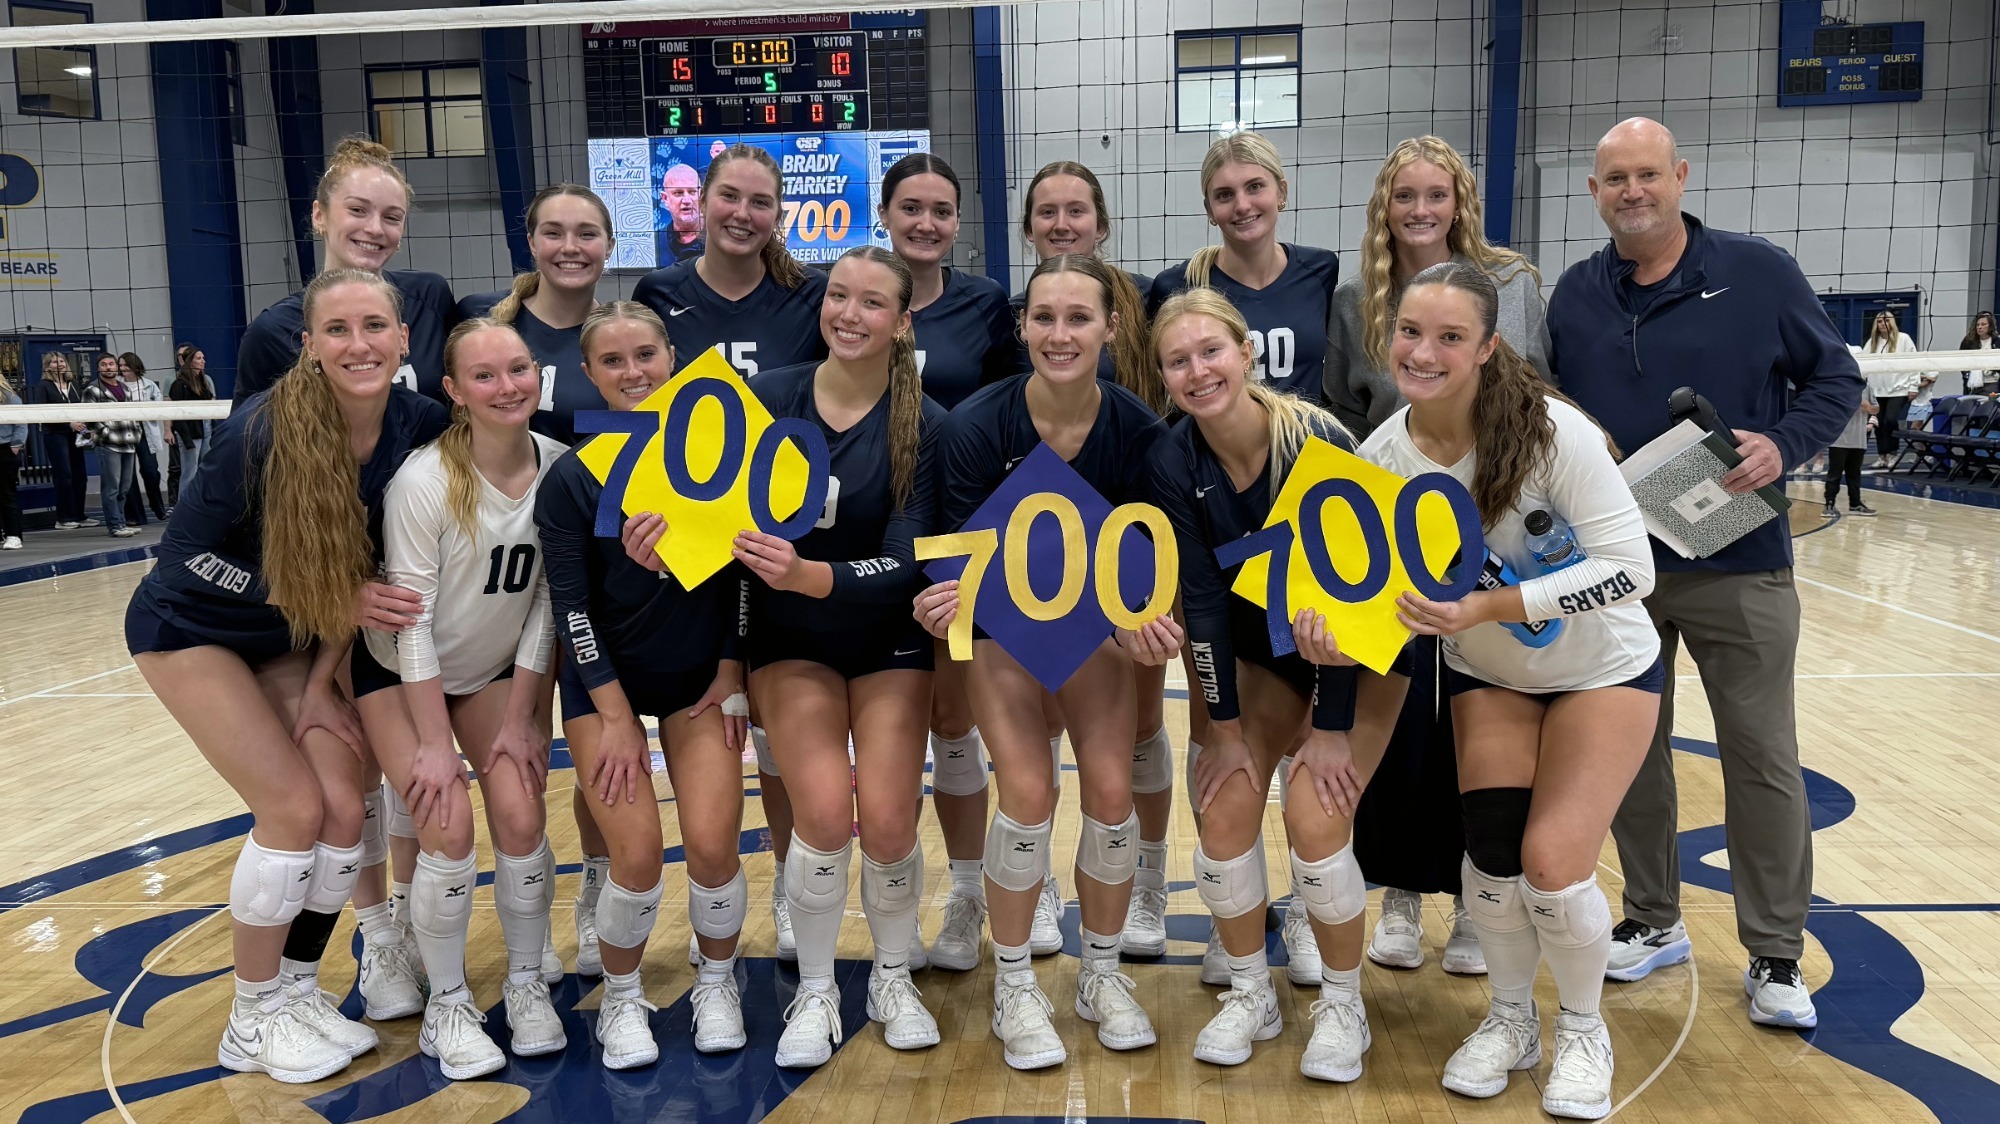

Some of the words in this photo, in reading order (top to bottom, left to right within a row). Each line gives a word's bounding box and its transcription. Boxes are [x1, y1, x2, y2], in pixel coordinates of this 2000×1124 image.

[713, 18, 737, 26] where
[738, 16, 786, 26] investments
[787, 14, 808, 24] build
[809, 14, 841, 24] ministry
[893, 30, 898, 38] F
[907, 29, 922, 38] PTS
[588, 40, 598, 48] NO
[623, 39, 637, 48] PTS
[659, 42, 689, 53] HOME
[813, 36, 853, 48] VISITOR
[732, 40, 789, 64] 0:00
[831, 52, 850, 75] 10
[1790, 58, 1822, 68] BEARS
[1838, 57, 1866, 66] PERIOD
[1883, 54, 1917, 63] GUEST
[672, 57, 692, 80] 15
[716, 68, 732, 76] POSS
[734, 76, 762, 85] PERIOD
[764, 72, 777, 92] 5
[817, 80, 842, 88] BONUS
[1841, 74, 1862, 82] POSS
[669, 84, 694, 92] BONUS
[1839, 83, 1866, 91] BONUS
[658, 98, 680, 107] FOULS
[716, 97, 743, 106] PLAYER
[750, 96, 777, 104] POINTS
[780, 95, 802, 103] FOULS
[809, 94, 823, 102] TOL
[832, 94, 854, 102] FOULS
[669, 107, 681, 127] 2
[696, 107, 702, 125] 1
[765, 105, 776, 123] 0
[811, 104, 823, 123] 0
[843, 102, 856, 122] 2
[836, 122, 852, 130] WON
[782, 154, 840, 174] BRADY
[597, 170, 622, 182] Green
[623, 170, 642, 180] Mill
[781, 199, 851, 242] 700
[789, 248, 819, 261] REER
[821, 247, 851, 261] WIN
[1, 262, 58, 275] BEARS
[1248, 326, 1295, 379] 20
[573, 376, 831, 541] 700
[483, 543, 537, 595] 10
[1213, 471, 1485, 658] 700
[184, 551, 252, 594] GOLDEN
[913, 491, 1179, 661] 700
[1557, 569, 1638, 615] BEARS
[567, 610, 600, 665] GOLDE
[1190, 640, 1220, 704] GOLDEN
